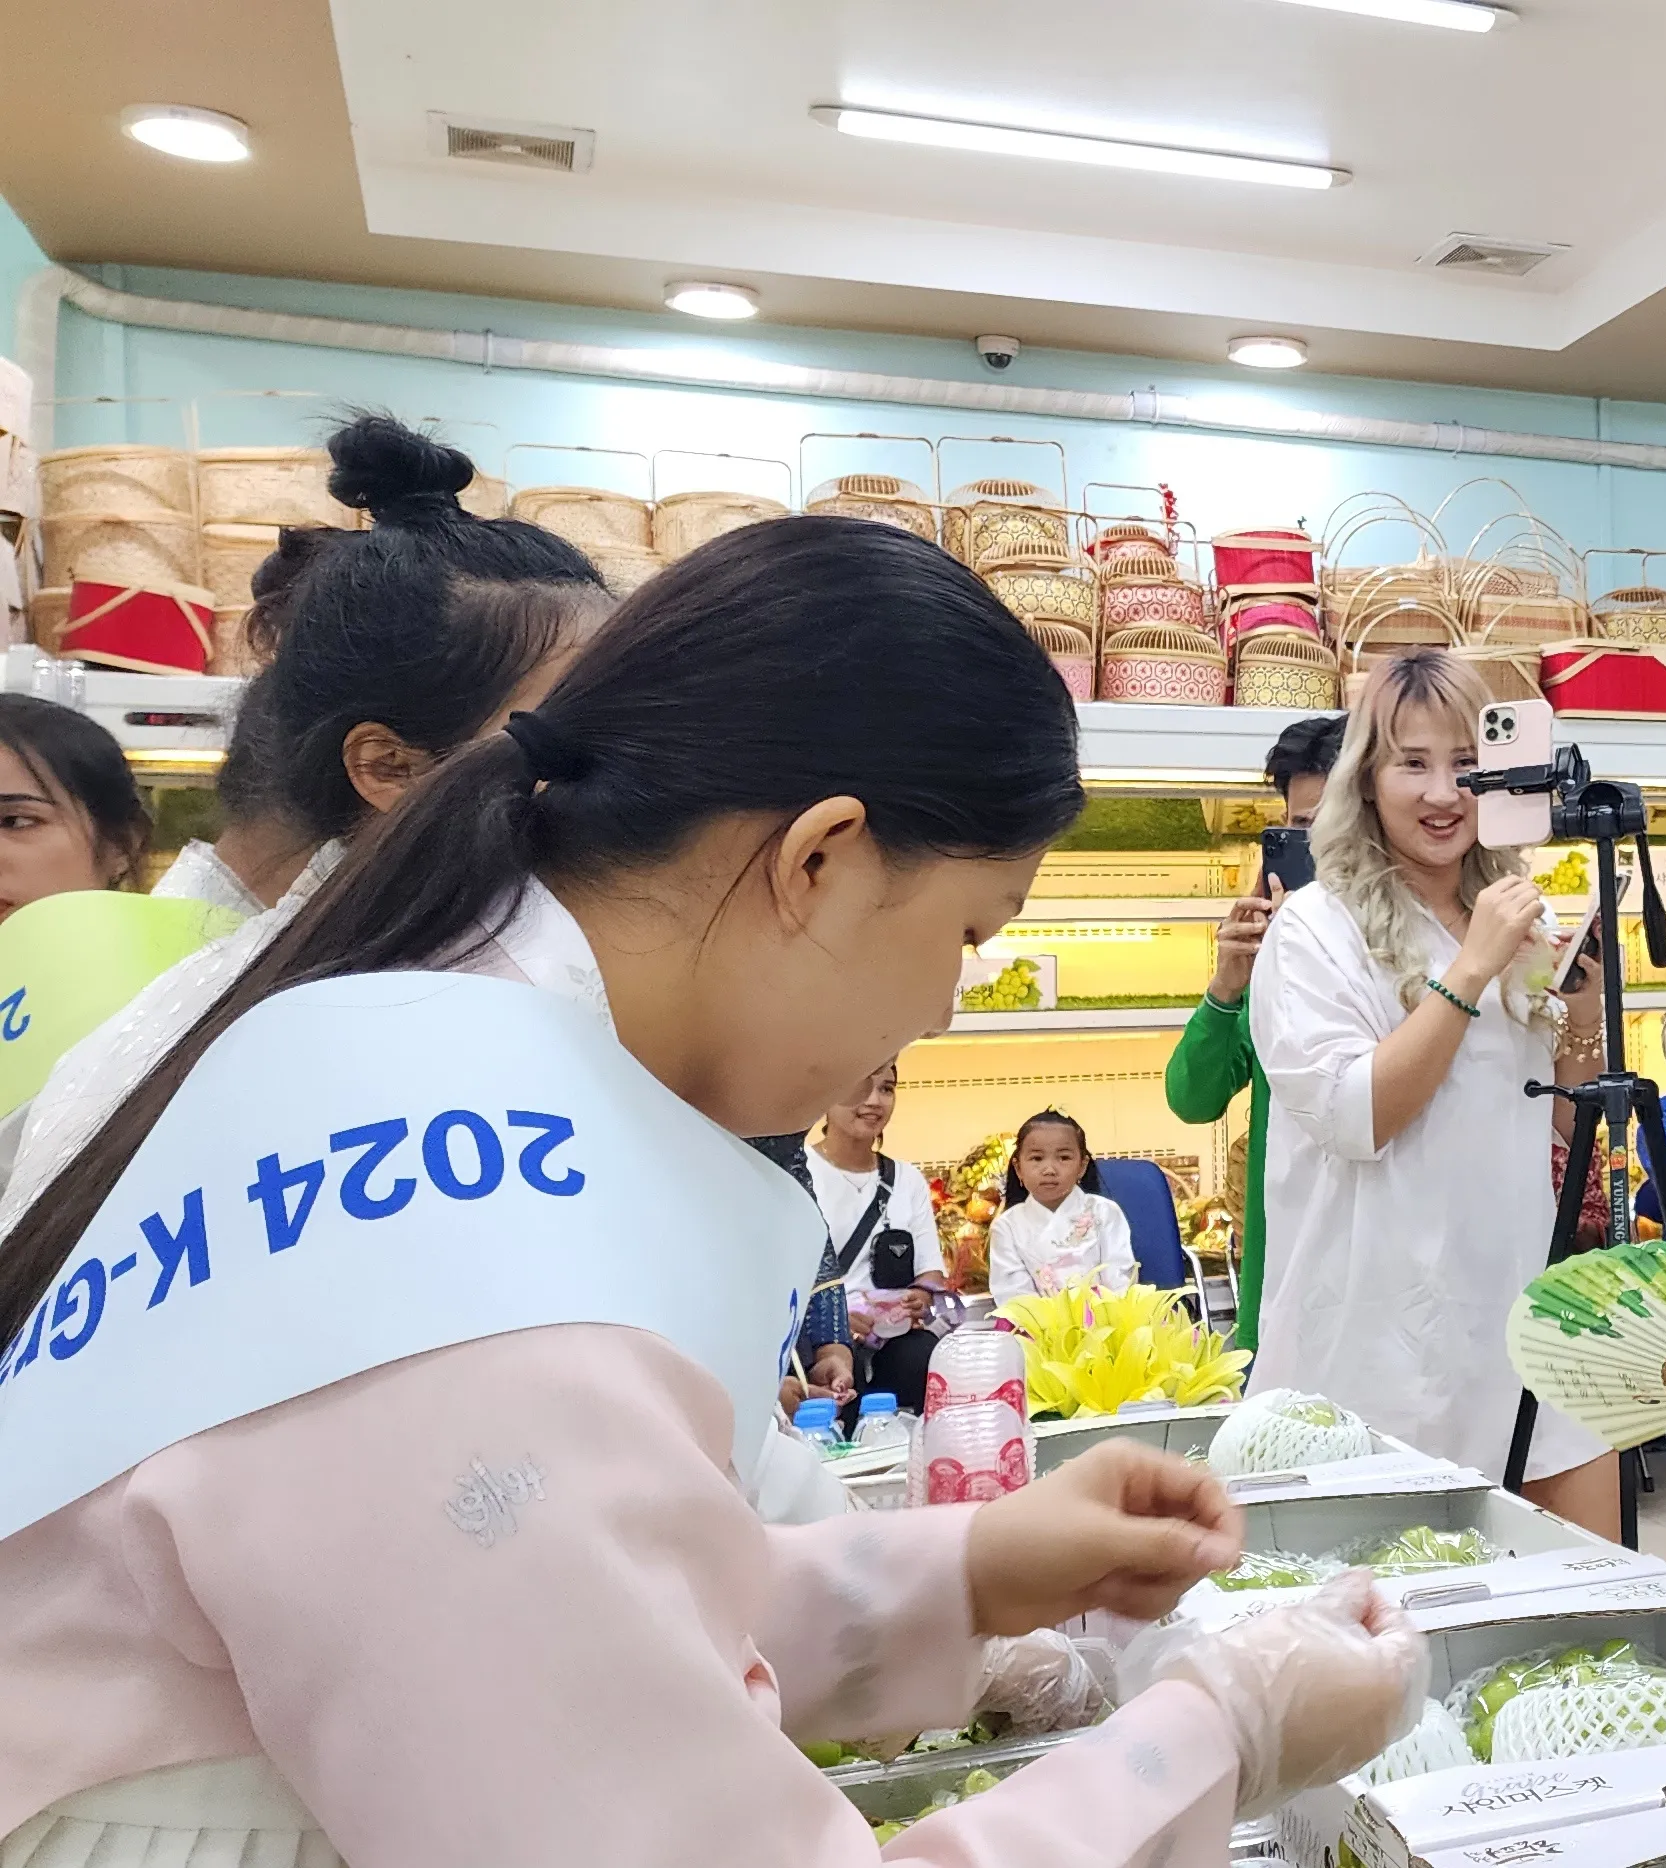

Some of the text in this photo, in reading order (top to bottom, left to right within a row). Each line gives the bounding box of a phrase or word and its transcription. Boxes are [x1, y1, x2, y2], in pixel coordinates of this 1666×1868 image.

[248, 1109, 586, 1254] 2024
[1613, 1179, 1626, 1241] YUNTENG
[1441, 1776, 1614, 1817] 샤인머스켓
